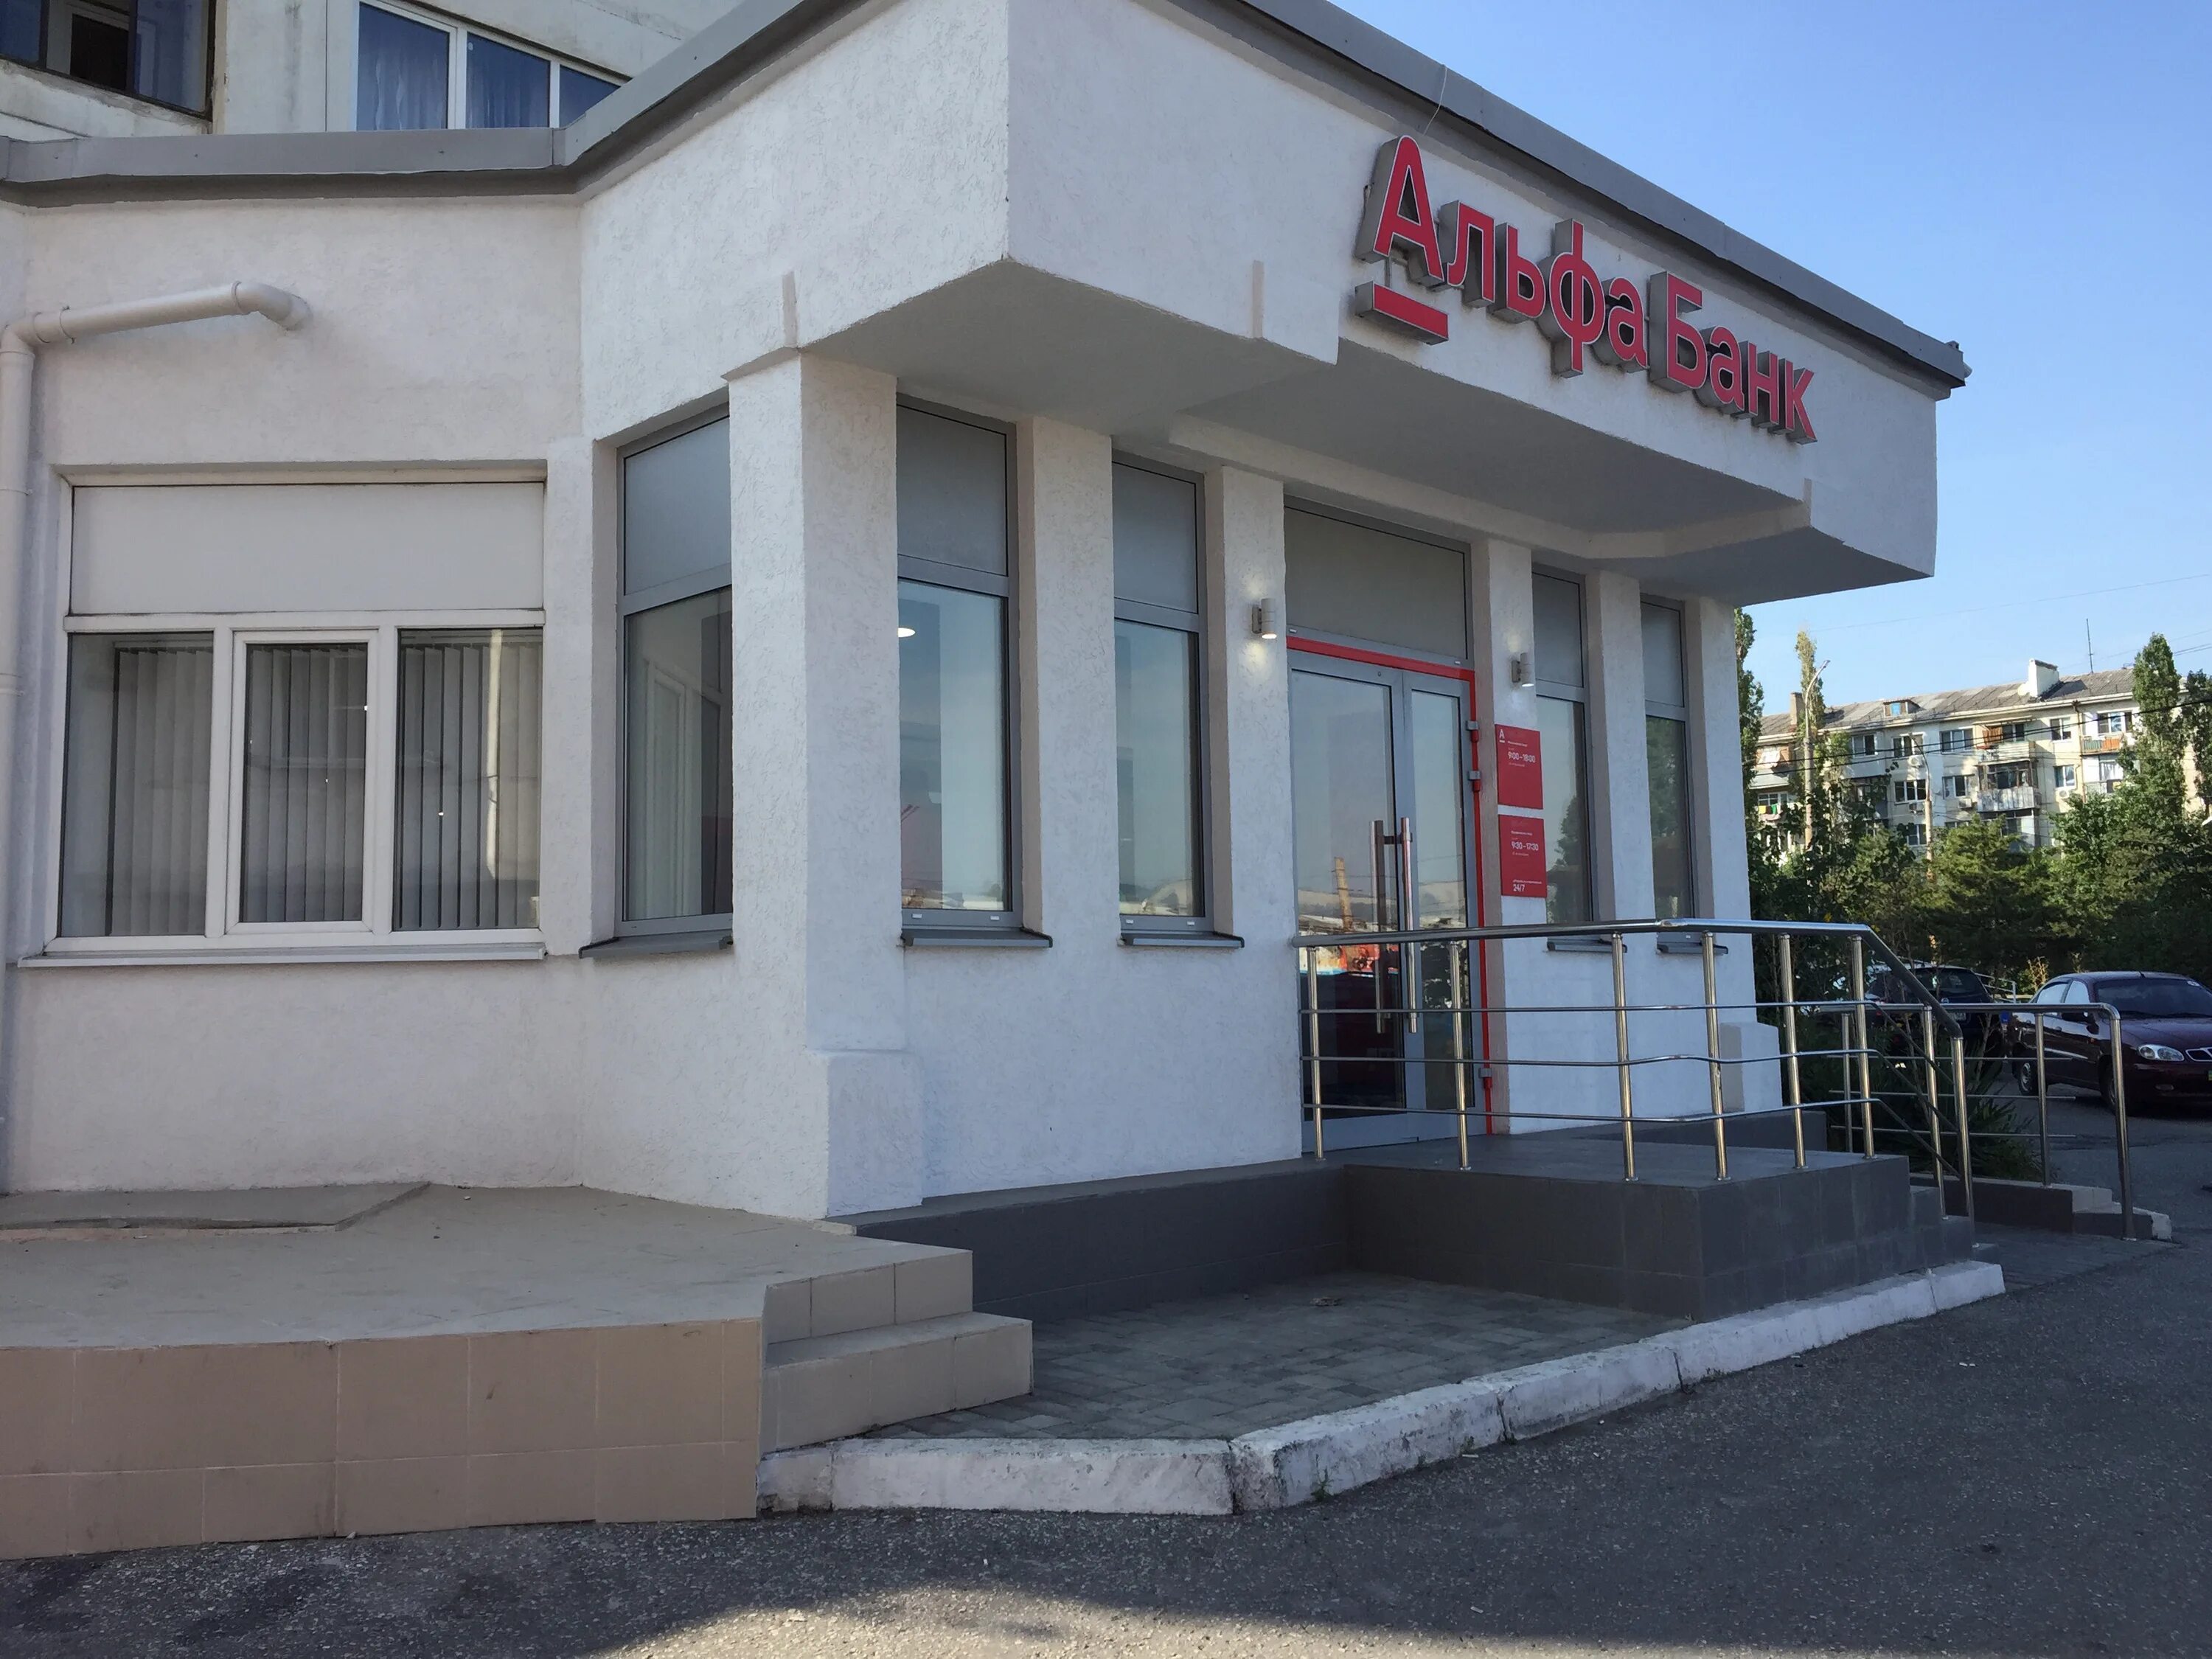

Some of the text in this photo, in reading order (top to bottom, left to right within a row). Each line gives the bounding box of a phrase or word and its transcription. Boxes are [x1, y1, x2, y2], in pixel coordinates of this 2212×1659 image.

[1370, 135, 1818, 443] Альфа Банк
[1513, 883, 1526, 892] 24/7
